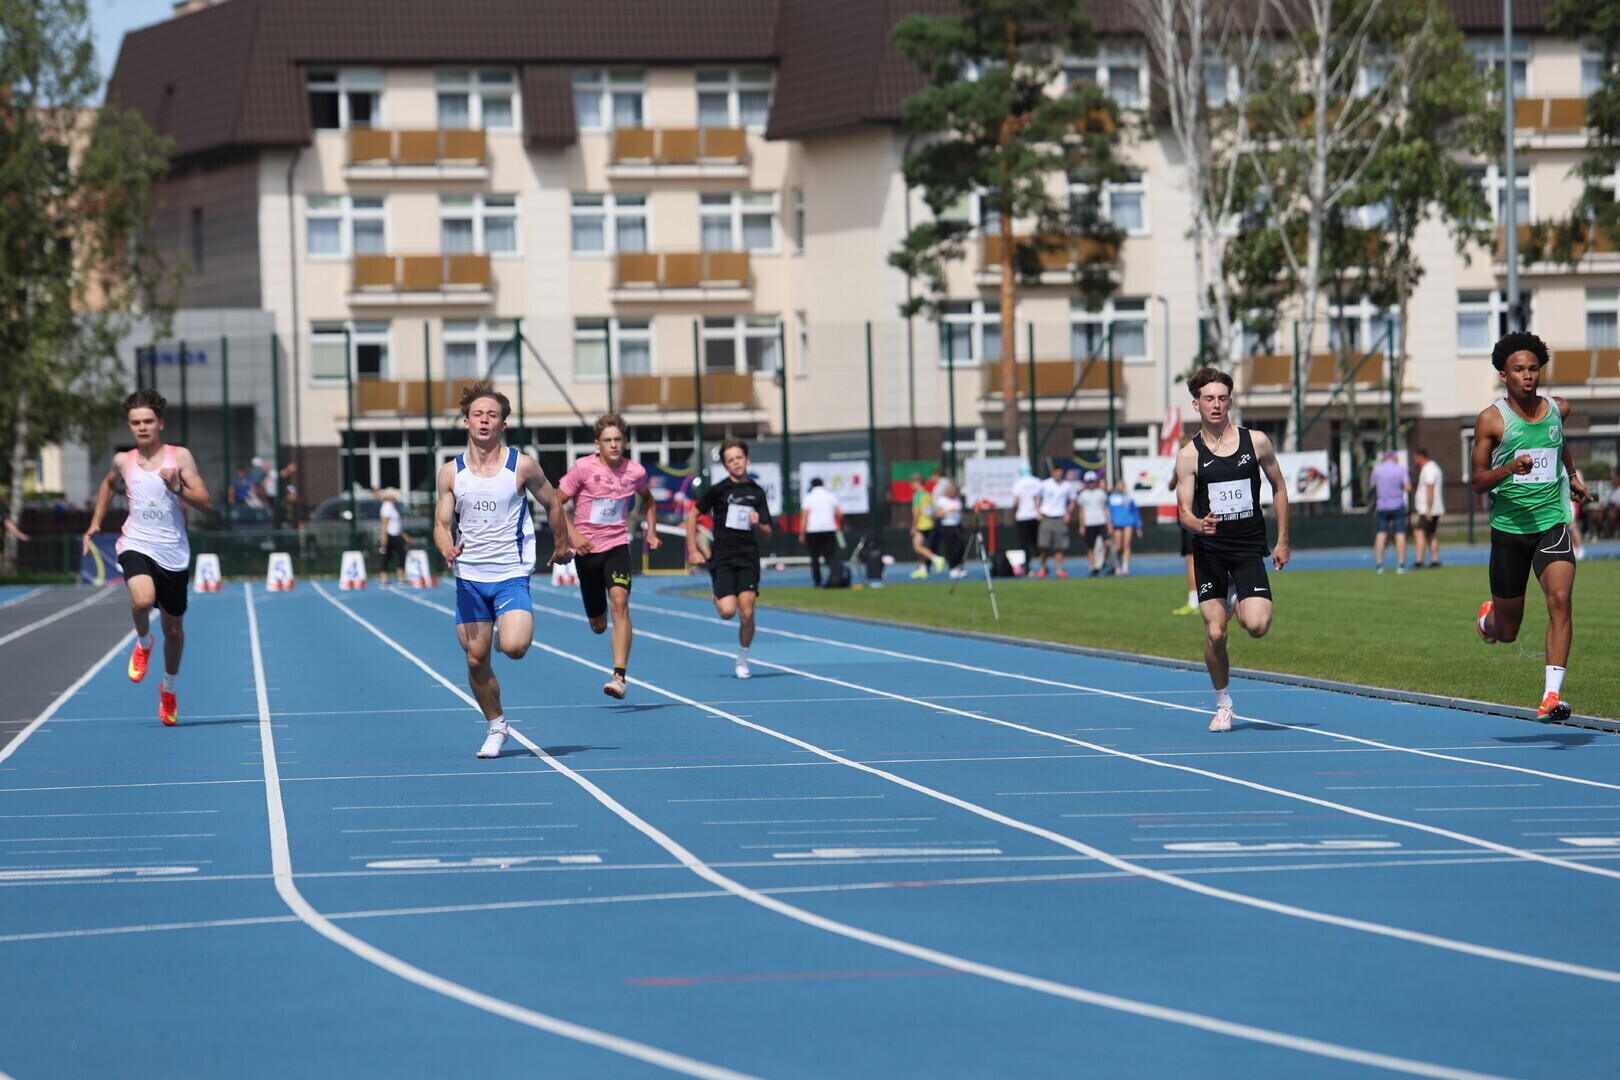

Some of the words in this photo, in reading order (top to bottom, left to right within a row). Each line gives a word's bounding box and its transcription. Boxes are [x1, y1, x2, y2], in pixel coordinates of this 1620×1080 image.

[1533, 457, 1548, 469] 50
[1219, 488, 1243, 502] 316
[473, 500, 497, 512] 490
[142, 510, 163, 520] 600
[273, 561, 288, 580] 5
[346, 559, 360, 578] 4
